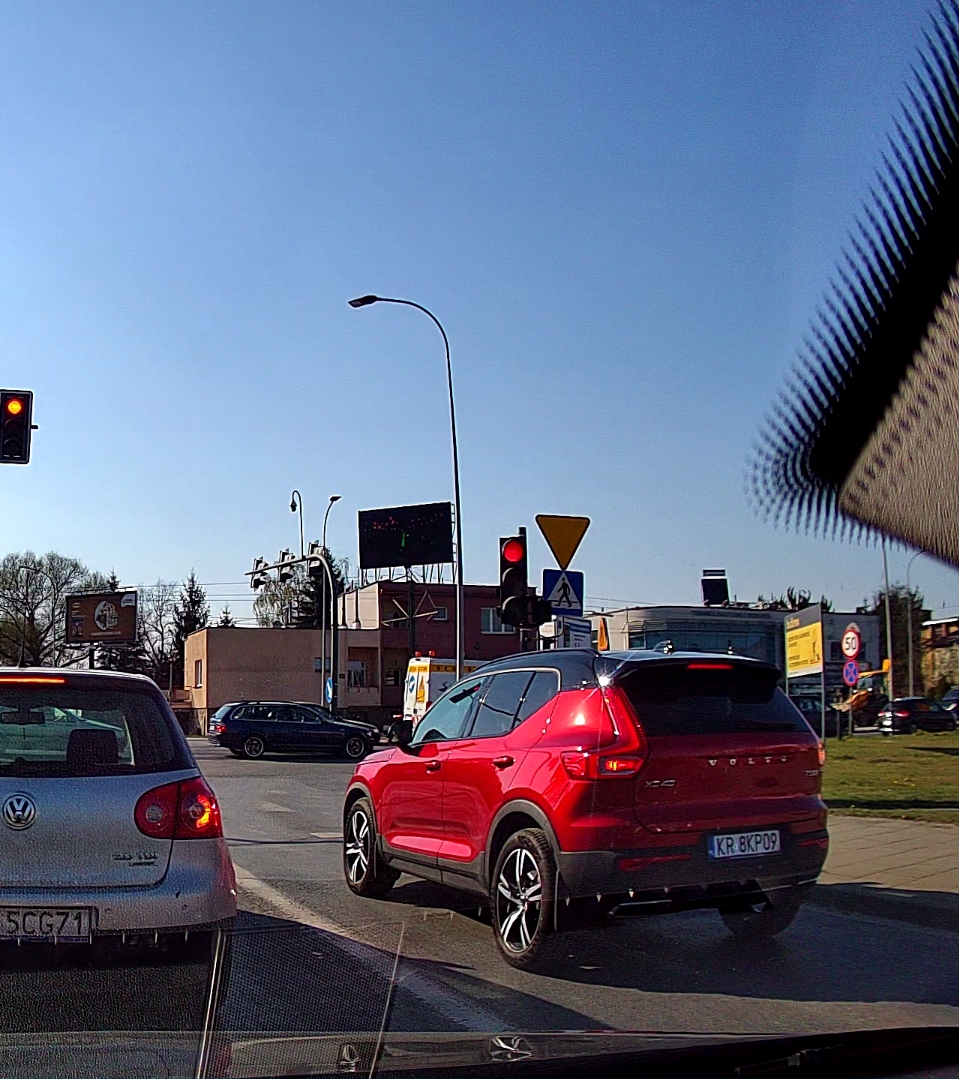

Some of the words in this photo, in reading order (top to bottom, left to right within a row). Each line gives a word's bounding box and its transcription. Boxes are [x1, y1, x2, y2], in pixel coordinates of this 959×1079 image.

[845, 637, 857, 651] 50
[716, 835, 736, 856] KR
[740, 832, 778, 853] 8KP09
[7, 910, 83, 936] 5CG71
